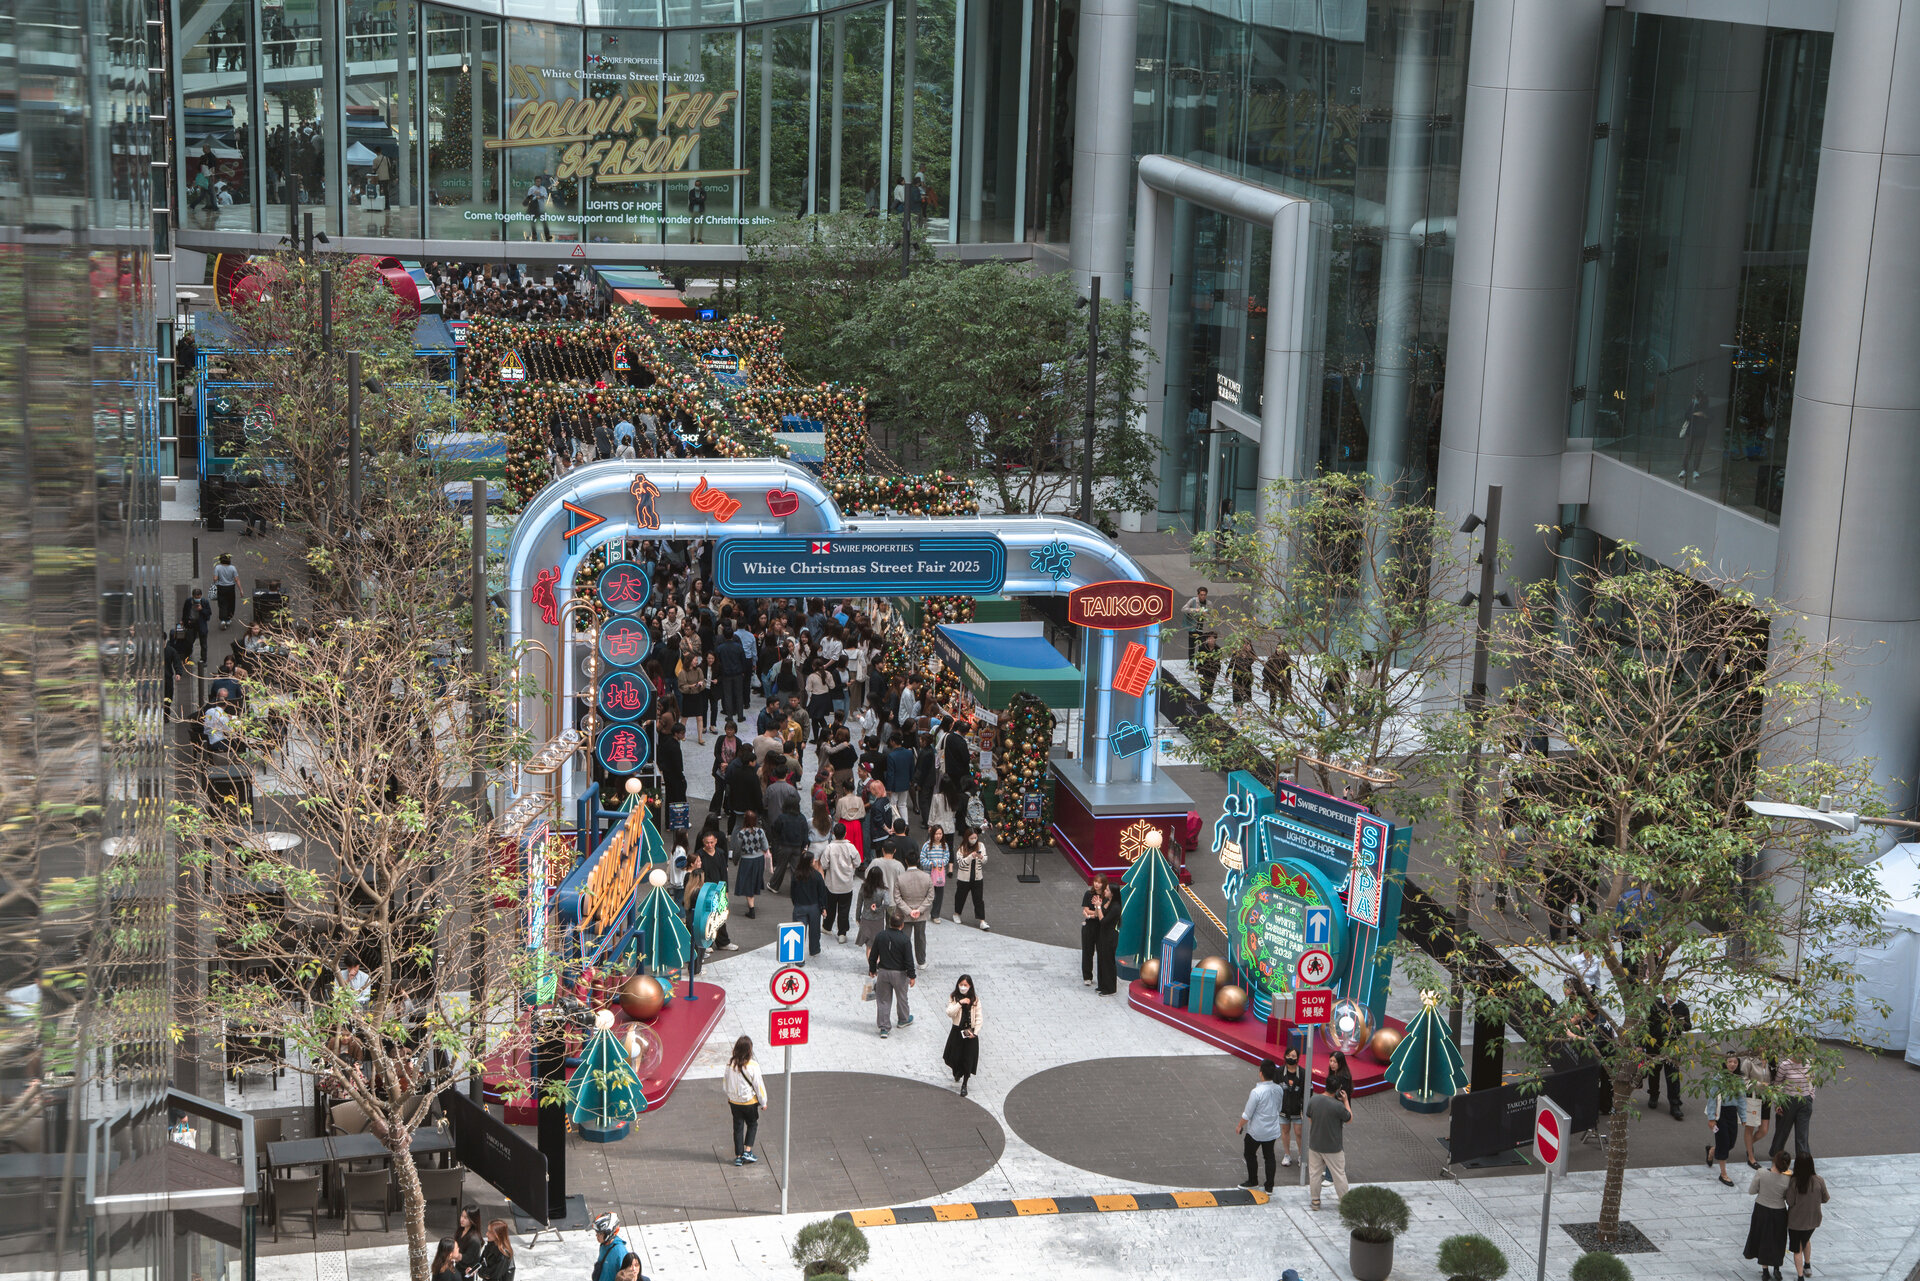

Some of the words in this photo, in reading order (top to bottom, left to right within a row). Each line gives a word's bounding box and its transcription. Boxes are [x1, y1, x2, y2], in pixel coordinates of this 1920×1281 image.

[542, 69, 572, 79] White
[574, 70, 627, 81] Christmas
[629, 71, 658, 81] Street
[662, 72, 681, 82] Fair
[684, 73, 705, 82] 2025
[508, 96, 647, 139] COLOUR
[657, 90, 739, 131] THE
[557, 133, 700, 180] SEASON
[586, 201, 616, 211] LIGHTS
[618, 201, 629, 210] OF
[632, 201, 662, 211] HOPE
[464, 211, 492, 221] Come
[494, 212, 537, 223] together,
[540, 213, 565, 222] show
[568, 213, 603, 224] support
[606, 213, 623, 223] and
[626, 214, 637, 223] let
[639, 214, 655, 224] the
[657, 215, 692, 224] wonder
[694, 215, 703, 224] of
[706, 216, 749, 225] Christmas
[832, 542, 860, 554] SWIRE
[862, 543, 914, 553] PROPERTIES
[743, 561, 786, 575] White
[791, 561, 866, 575] Christmas
[870, 561, 914, 575] Street
[917, 560, 947, 574] Fair
[950, 560, 980, 574] 2025
[1080, 594, 1163, 618] TAIKOO
[607, 573, 643, 763] 太古地產
[1297, 798, 1318, 813] SWIRE
[1319, 806, 1356, 826] PROPERTIES
[1286, 831, 1307, 845] LIGHTS
[1308, 839, 1317, 848] OF
[1318, 842, 1335, 856] HOPE
[1356, 826, 1378, 918] SPPA
[1274, 914, 1296, 930] WHITE
[1264, 931, 1288, 948] STREET
[1289, 940, 1304, 953] FAIR
[1273, 946, 1292, 959] 2025
[1302, 996, 1326, 1005] SLOW
[1302, 1007, 1324, 1018] 慢駛
[778, 1017, 802, 1026] SLOW
[778, 1027, 801, 1039] 慢駛
[1507, 1100, 1527, 1110] TAIKOO
